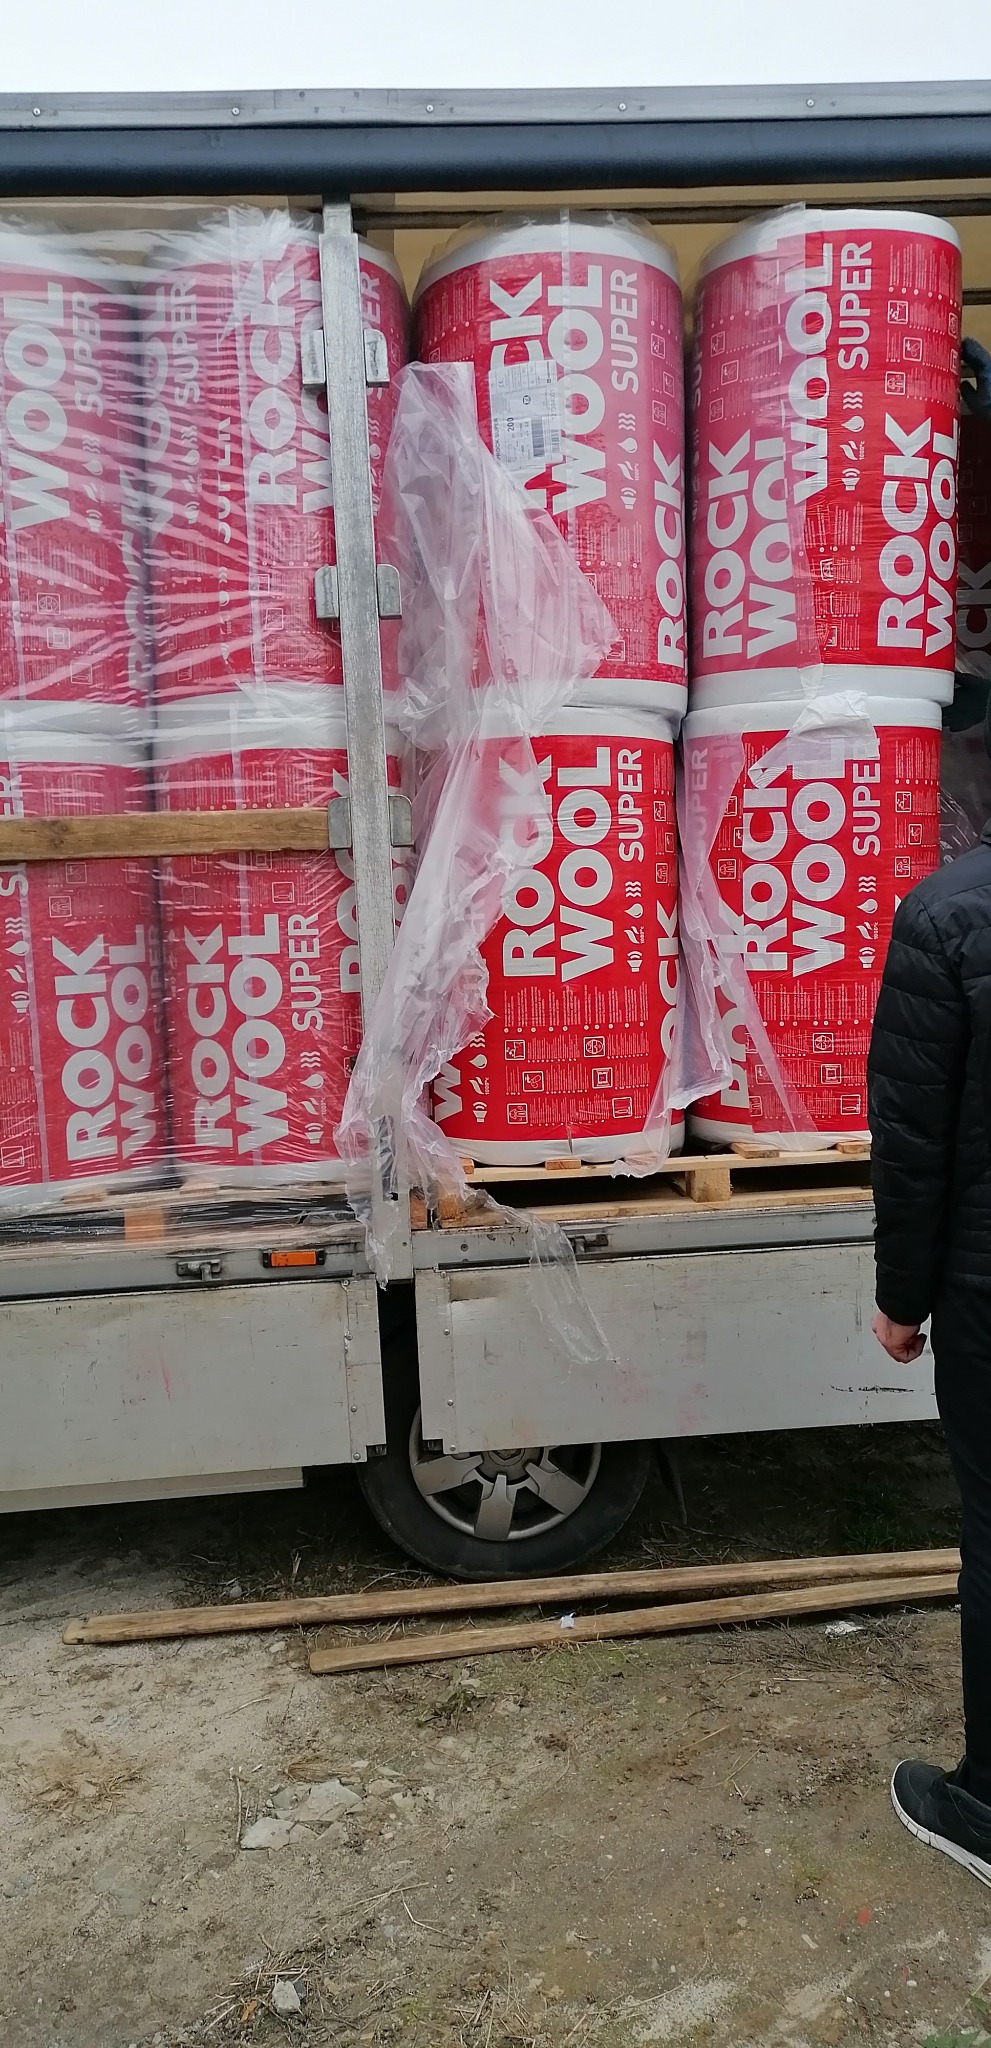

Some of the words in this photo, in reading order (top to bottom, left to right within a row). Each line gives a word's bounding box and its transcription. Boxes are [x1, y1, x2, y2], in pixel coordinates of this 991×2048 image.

[3, 282, 70, 530] WOOL
[72, 292, 102, 417] SUPER
[173, 277, 200, 404] SUPER
[248, 263, 298, 506] ROCK
[547, 264, 607, 516] WOOL
[610, 269, 639, 395] SUPER
[784, 243, 833, 509] WOOL
[837, 241, 873, 371] SUPER
[506, 417, 515, 432] 200
[877, 412, 931, 648] ROCK
[925, 417, 958, 657] WOOL
[652, 440, 684, 667] ROCK
[703, 429, 751, 658] ROCK
[0, 774, 29, 897] SER
[499, 753, 556, 977] ROCK
[557, 746, 614, 982] WOOL
[617, 748, 643, 862] SUPER
[791, 737, 846, 977] WOOL
[52, 934, 118, 1160] ROCK
[109, 924, 157, 1159] WOOL
[184, 924, 234, 1148] ROCK
[228, 913, 290, 1155] WOOL
[287, 913, 324, 1032] SUPER
